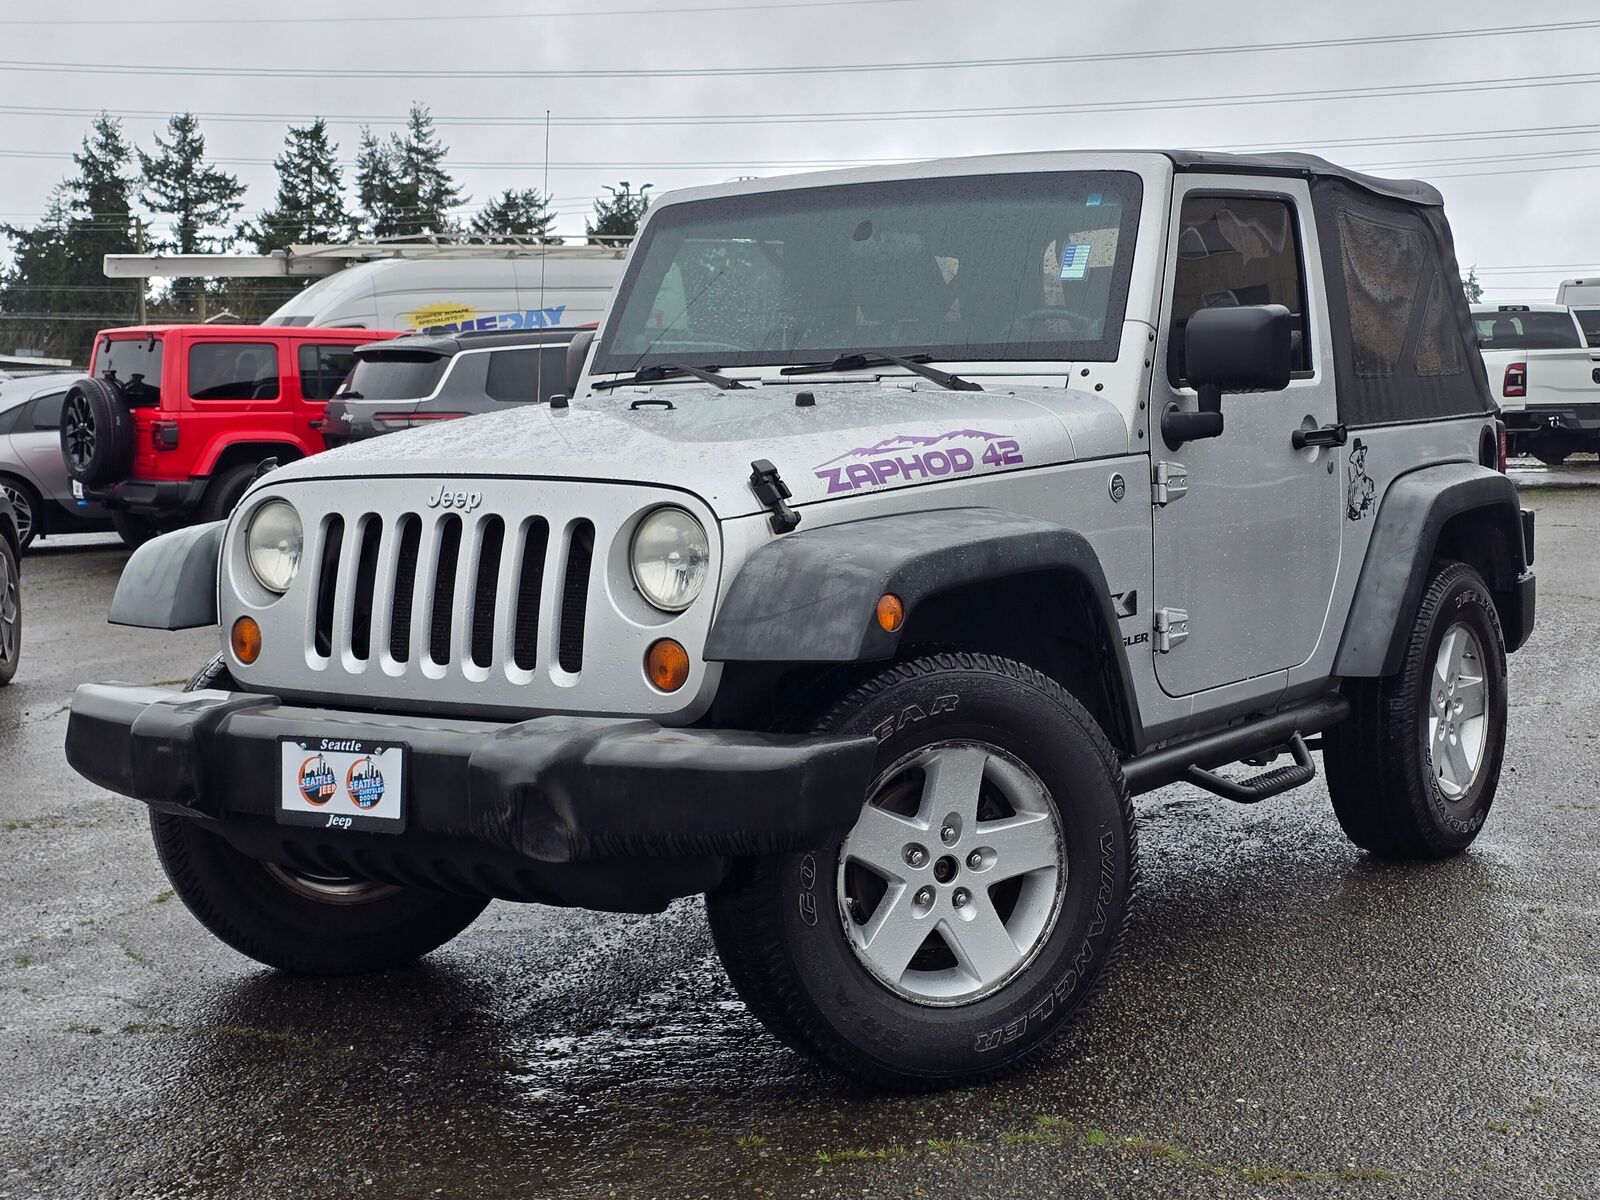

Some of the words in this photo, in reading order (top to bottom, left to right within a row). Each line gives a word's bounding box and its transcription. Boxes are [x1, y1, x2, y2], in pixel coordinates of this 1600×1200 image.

[814, 447, 975, 494] ZAPHOD
[982, 440, 1024, 467] 42
[427, 485, 483, 514] Jeep
[320, 738, 362, 752] Seattle
[300, 774, 333, 788] SEATTLE
[348, 777, 381, 791] SEATTLE
[319, 783, 337, 798] JEEP
[359, 786, 385, 796] CHRYSLER
[326, 814, 353, 829] Jeep
[974, 830, 1115, 1053] WRANGLER
